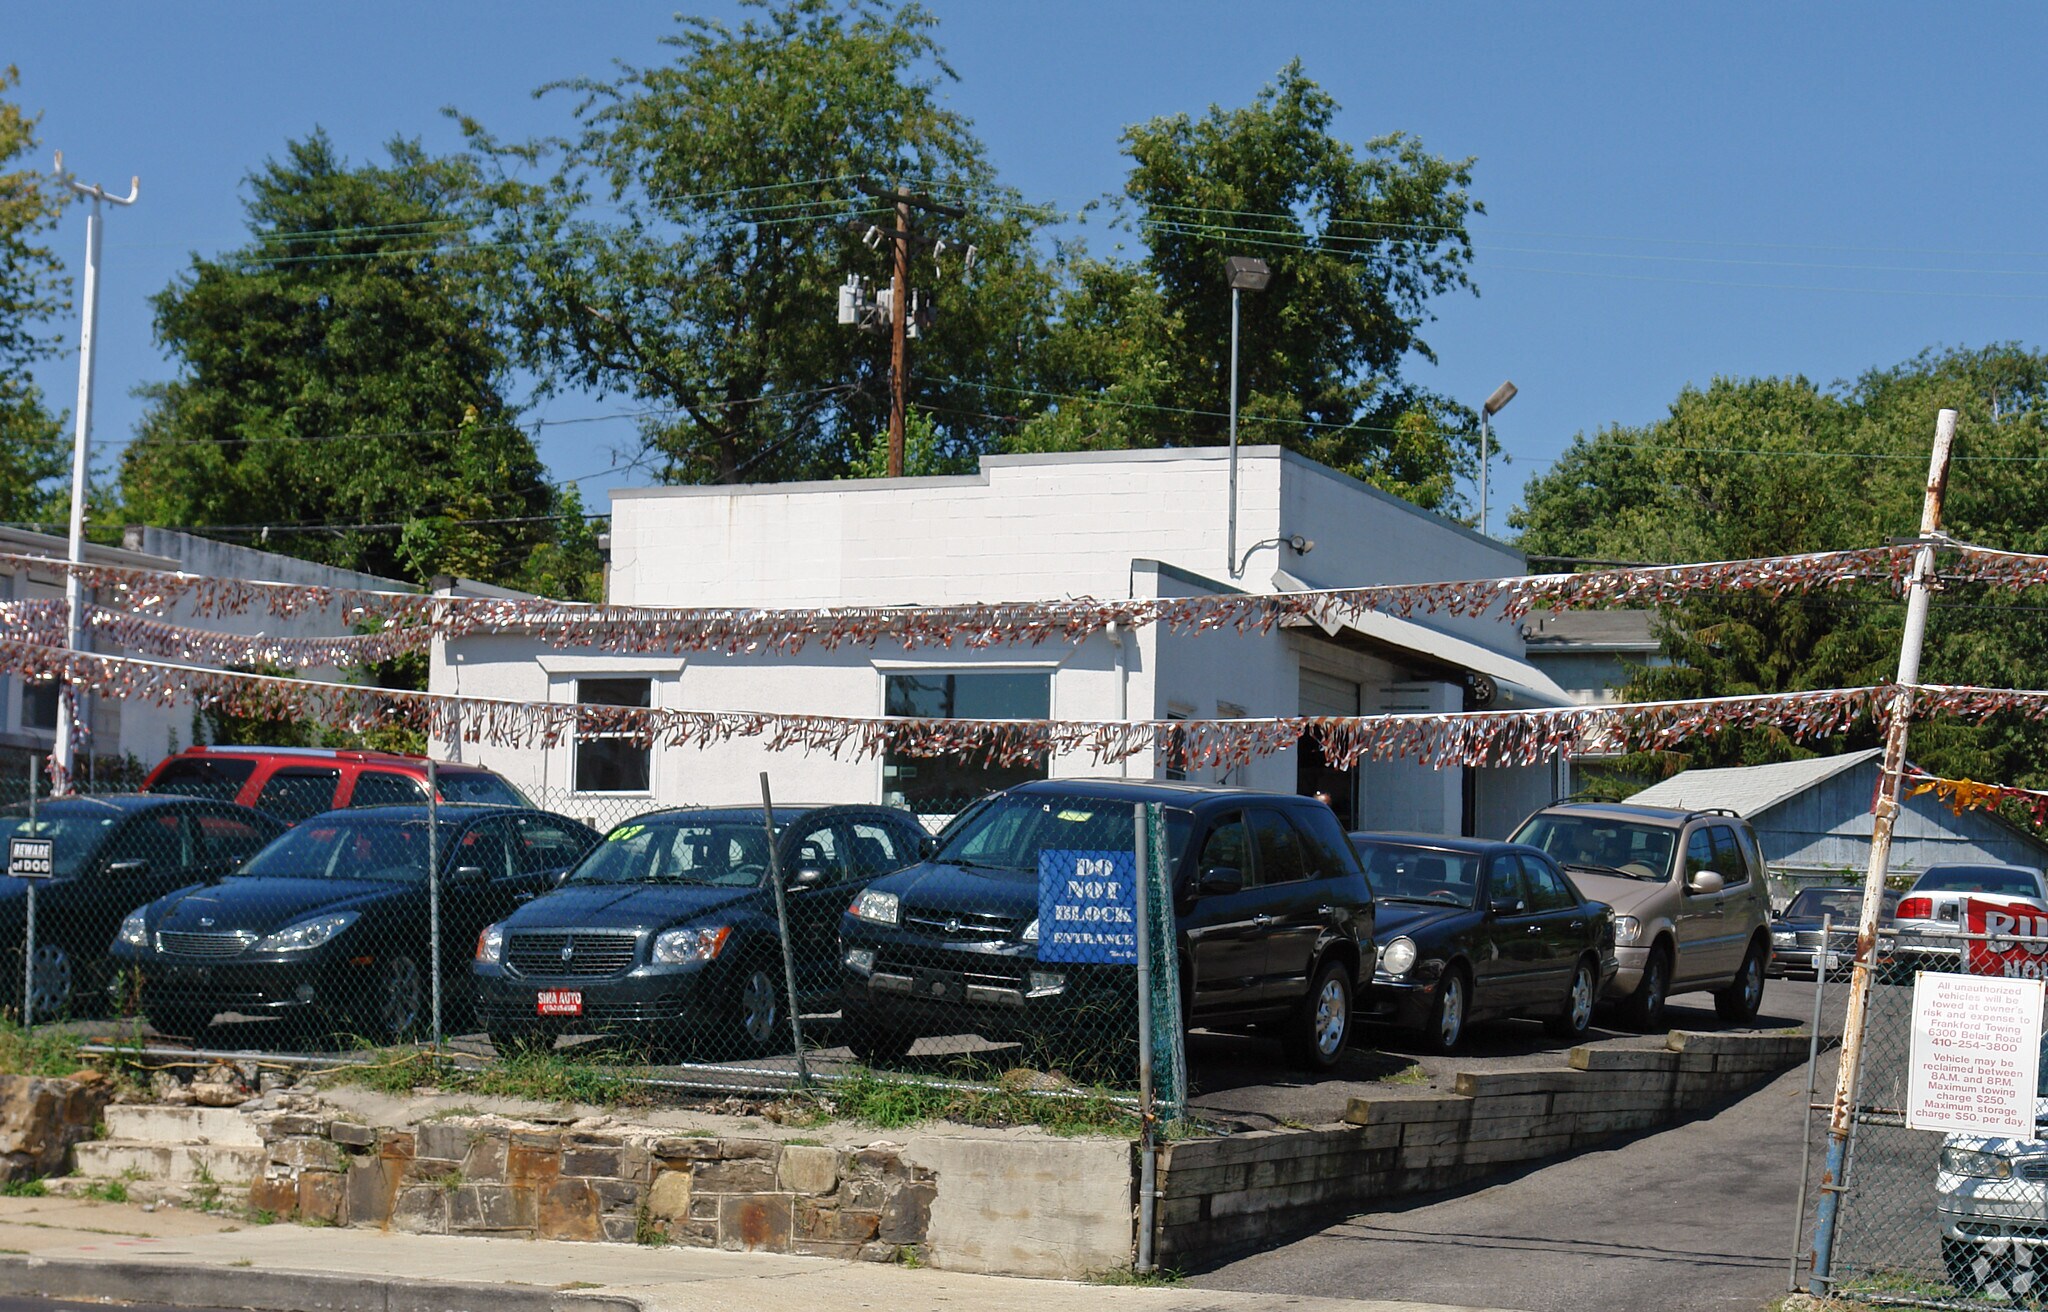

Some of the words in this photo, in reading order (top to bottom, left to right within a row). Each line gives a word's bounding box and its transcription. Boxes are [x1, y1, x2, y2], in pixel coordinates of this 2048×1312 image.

[14, 843, 49, 856] BEWARE
[12, 860, 23, 871] of
[24, 860, 49, 872] DOG
[1076, 858, 1113, 877] DO
[1067, 881, 1121, 899] NOT
[1055, 905, 1132, 923] BLOCK
[1054, 932, 1134, 945] ENTRANCE
[1937, 982, 1950, 990] All
[1954, 984, 2022, 996] unauthorized
[559, 992, 582, 1004] AUTO
[1938, 992, 1981, 1002] vehicles
[1985, 995, 2001, 1003] will
[2006, 996, 2019, 1005] be
[1932, 1000, 1964, 1010] towed
[1968, 1003, 1979, 1011] at
[1983, 1004, 2024, 1015] owner's
[1923, 1009, 1942, 1017] risk
[1946, 1011, 1966, 1019] and
[1970, 1014, 2015, 1023] expense
[2020, 1016, 2030, 1025] to
[1931, 1019, 1981, 1030] Frankford
[1986, 1023, 2021, 1035] Towing
[1928, 1028, 1957, 1038] 6300
[1961, 1031, 1991, 1041] Belair
[1995, 1033, 2022, 1043] Road
[1931, 1038, 2018, 1052] 410-254-3800
[1933, 1053, 1970, 1064] Vehicle
[1974, 1058, 1996, 1068] may
[2000, 1059, 2014, 1067] be
[1923, 1063, 1974, 1074] reclaimed
[1977, 1067, 2023, 1078] between
[1931, 1071, 1960, 1082] 8A.M.
[1963, 1076, 1983, 1084] and
[1986, 1077, 2014, 1087] 8P.M.
[1928, 1081, 1977, 1093] Maximum
[1981, 1086, 2016, 1098] towing
[1936, 1092, 1972, 1103] charge
[1976, 1094, 2007, 1105] $250.
[1924, 1099, 1973, 1111] Maximum
[1977, 1105, 2017, 1117] storage
[1915, 1109, 1951, 1120] charge
[1955, 1112, 1980, 1122] $50.
[1982, 1115, 2001, 1124] per
[2004, 1117, 2026, 1127] day.
